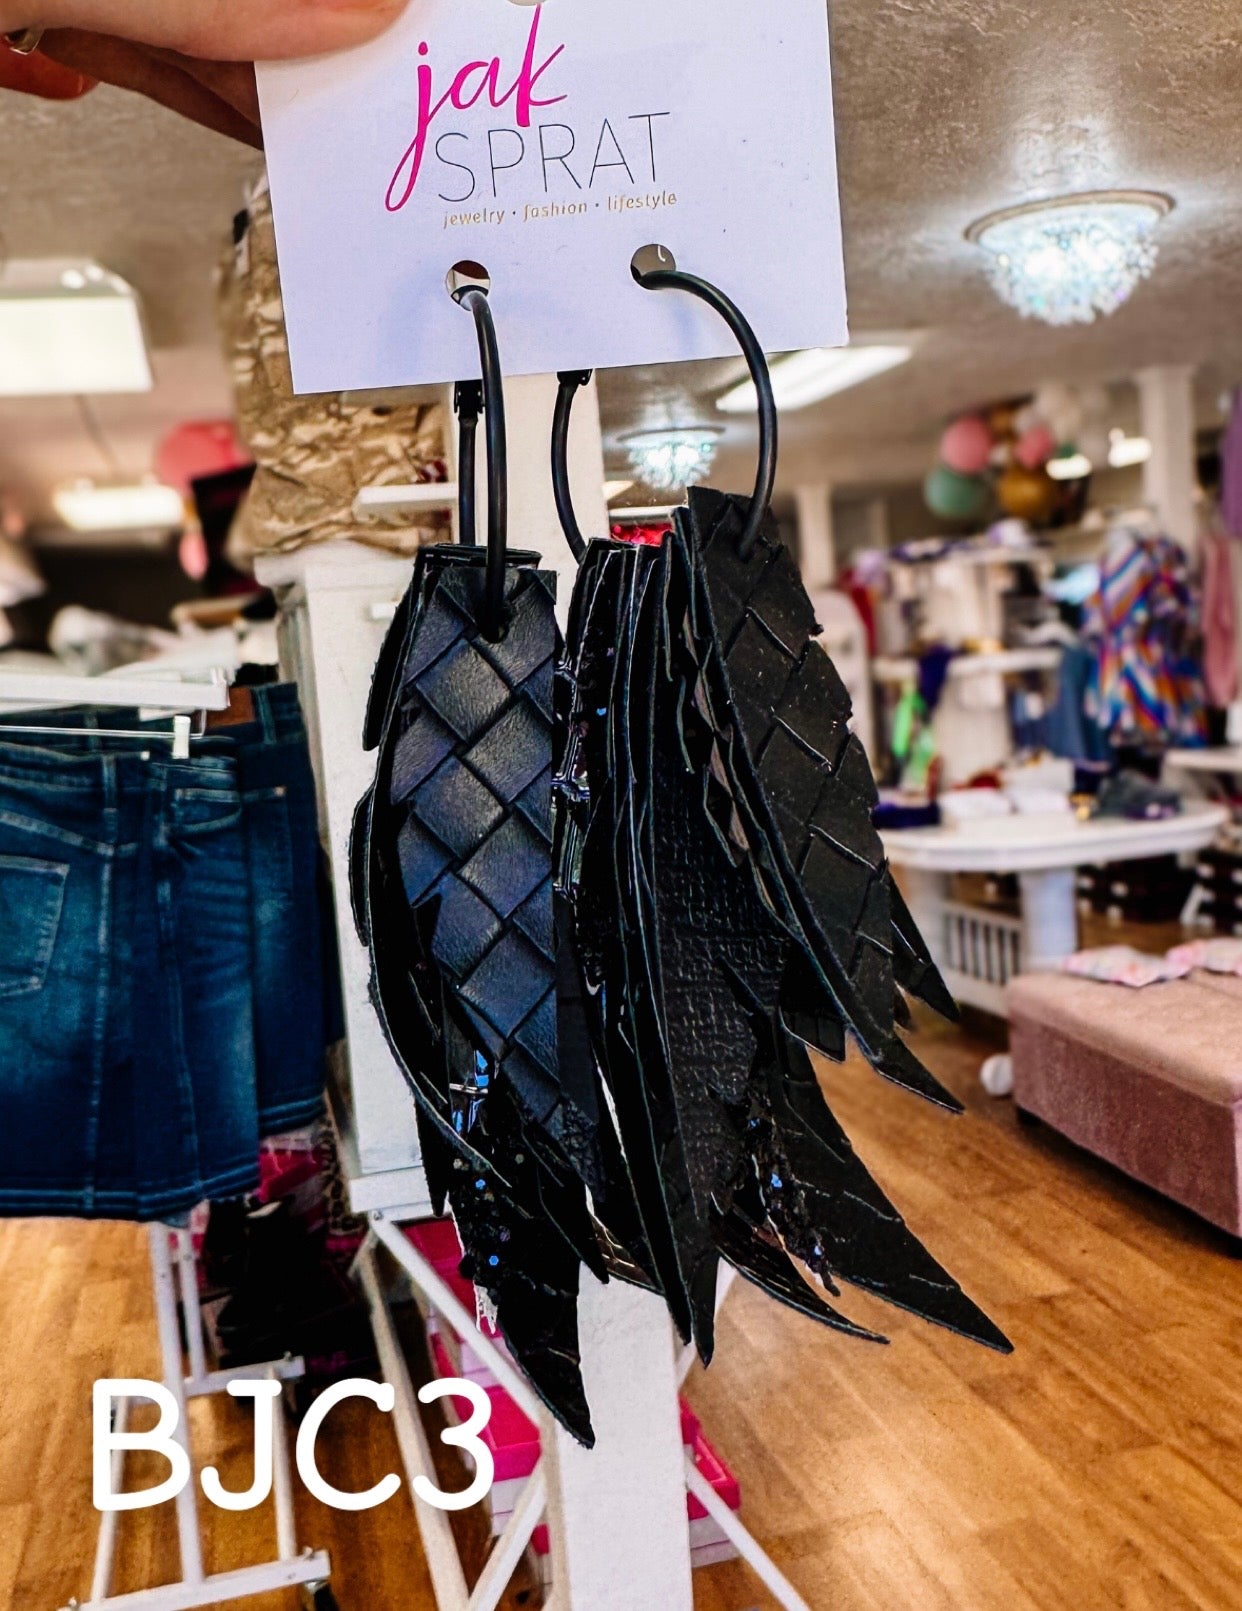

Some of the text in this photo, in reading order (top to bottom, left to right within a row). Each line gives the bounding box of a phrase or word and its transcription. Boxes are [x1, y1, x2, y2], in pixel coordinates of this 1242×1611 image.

[385, 4, 568, 212] jak
[435, 111, 671, 203] SPRAT
[442, 190, 678, 228] jewelry fashion lifestyle
